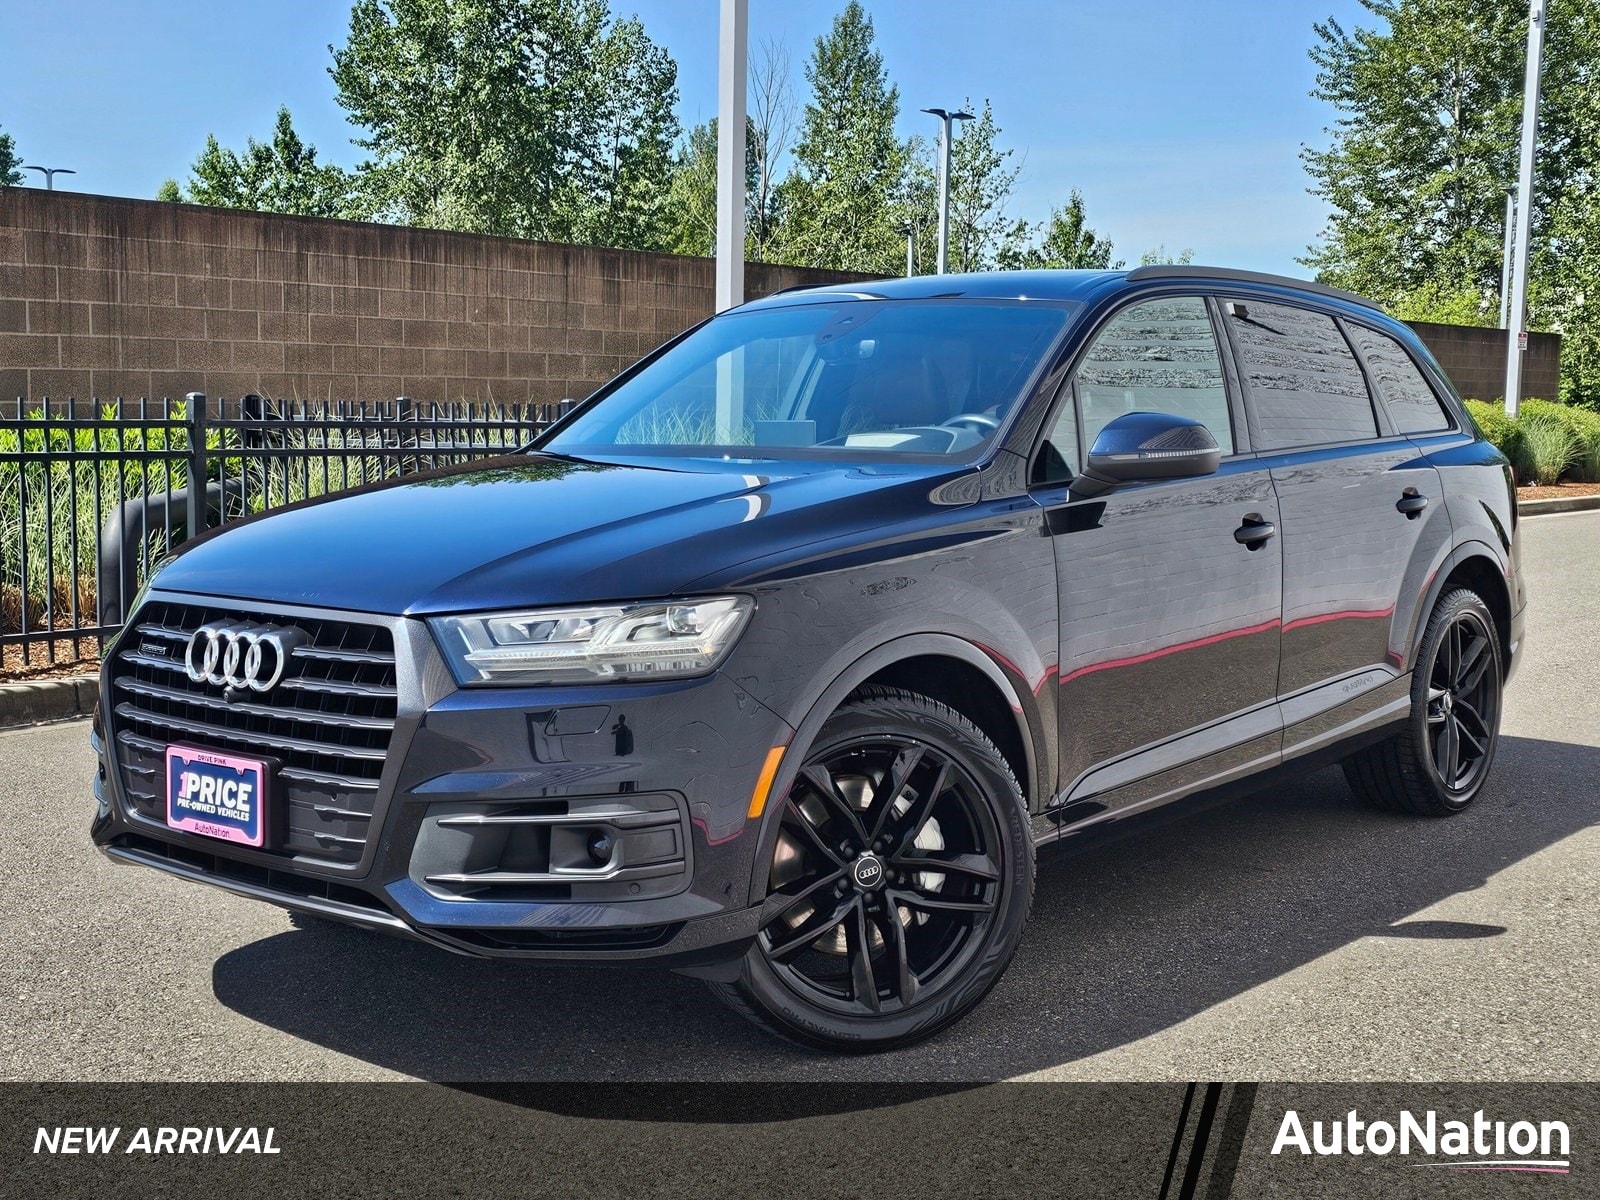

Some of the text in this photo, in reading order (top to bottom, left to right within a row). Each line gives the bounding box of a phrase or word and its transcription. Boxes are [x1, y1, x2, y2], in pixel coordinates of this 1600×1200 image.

[198, 754, 213, 763] DRIVE
[177, 798, 250, 821] PRE-OWNED VEHICLES
